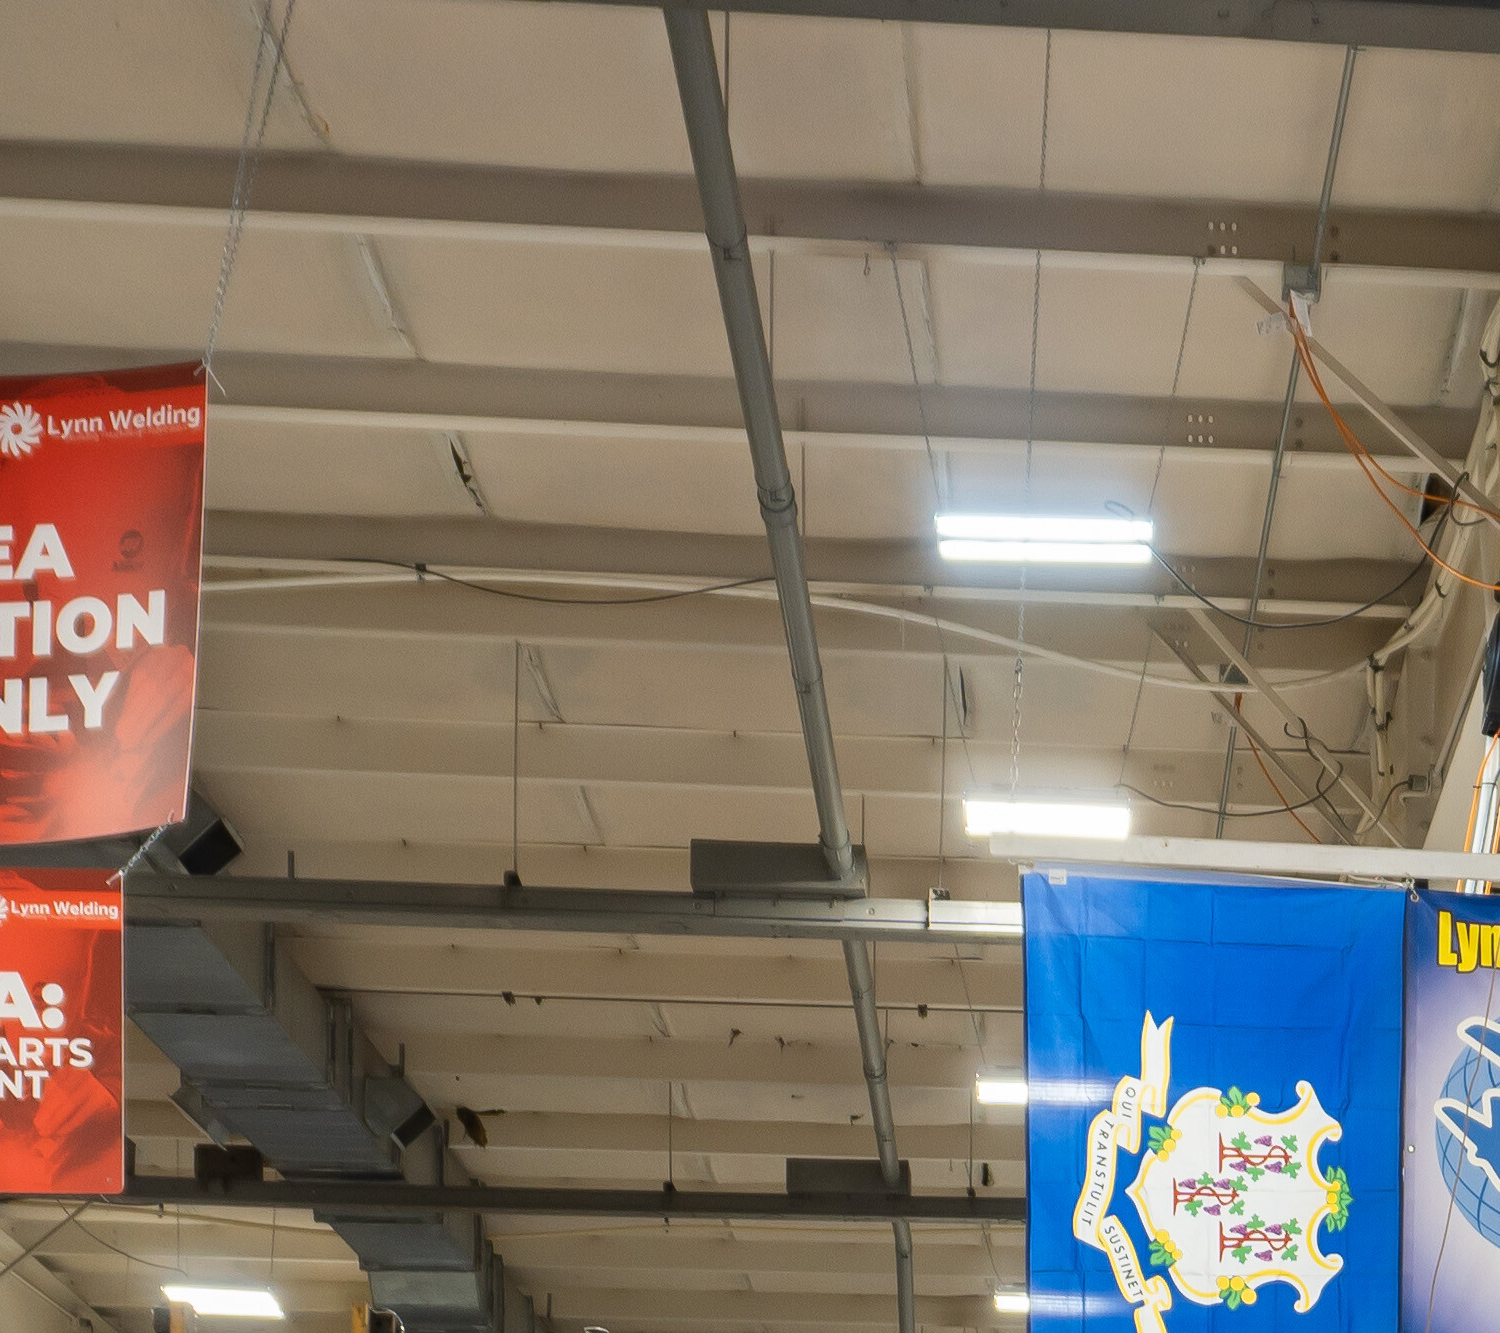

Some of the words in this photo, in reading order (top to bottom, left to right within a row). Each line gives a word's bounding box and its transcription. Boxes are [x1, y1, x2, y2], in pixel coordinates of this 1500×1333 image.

[46, 414, 103, 440] Lynn
[109, 404, 201, 431] Welding
[10, 901, 49, 921] Lynn
[53, 901, 120, 920] Welding
[1120, 1086, 1137, 1119] QUI
[1081, 1119, 1115, 1227] TRANSTULIT
[1104, 1225, 1144, 1299] SUSTINET
